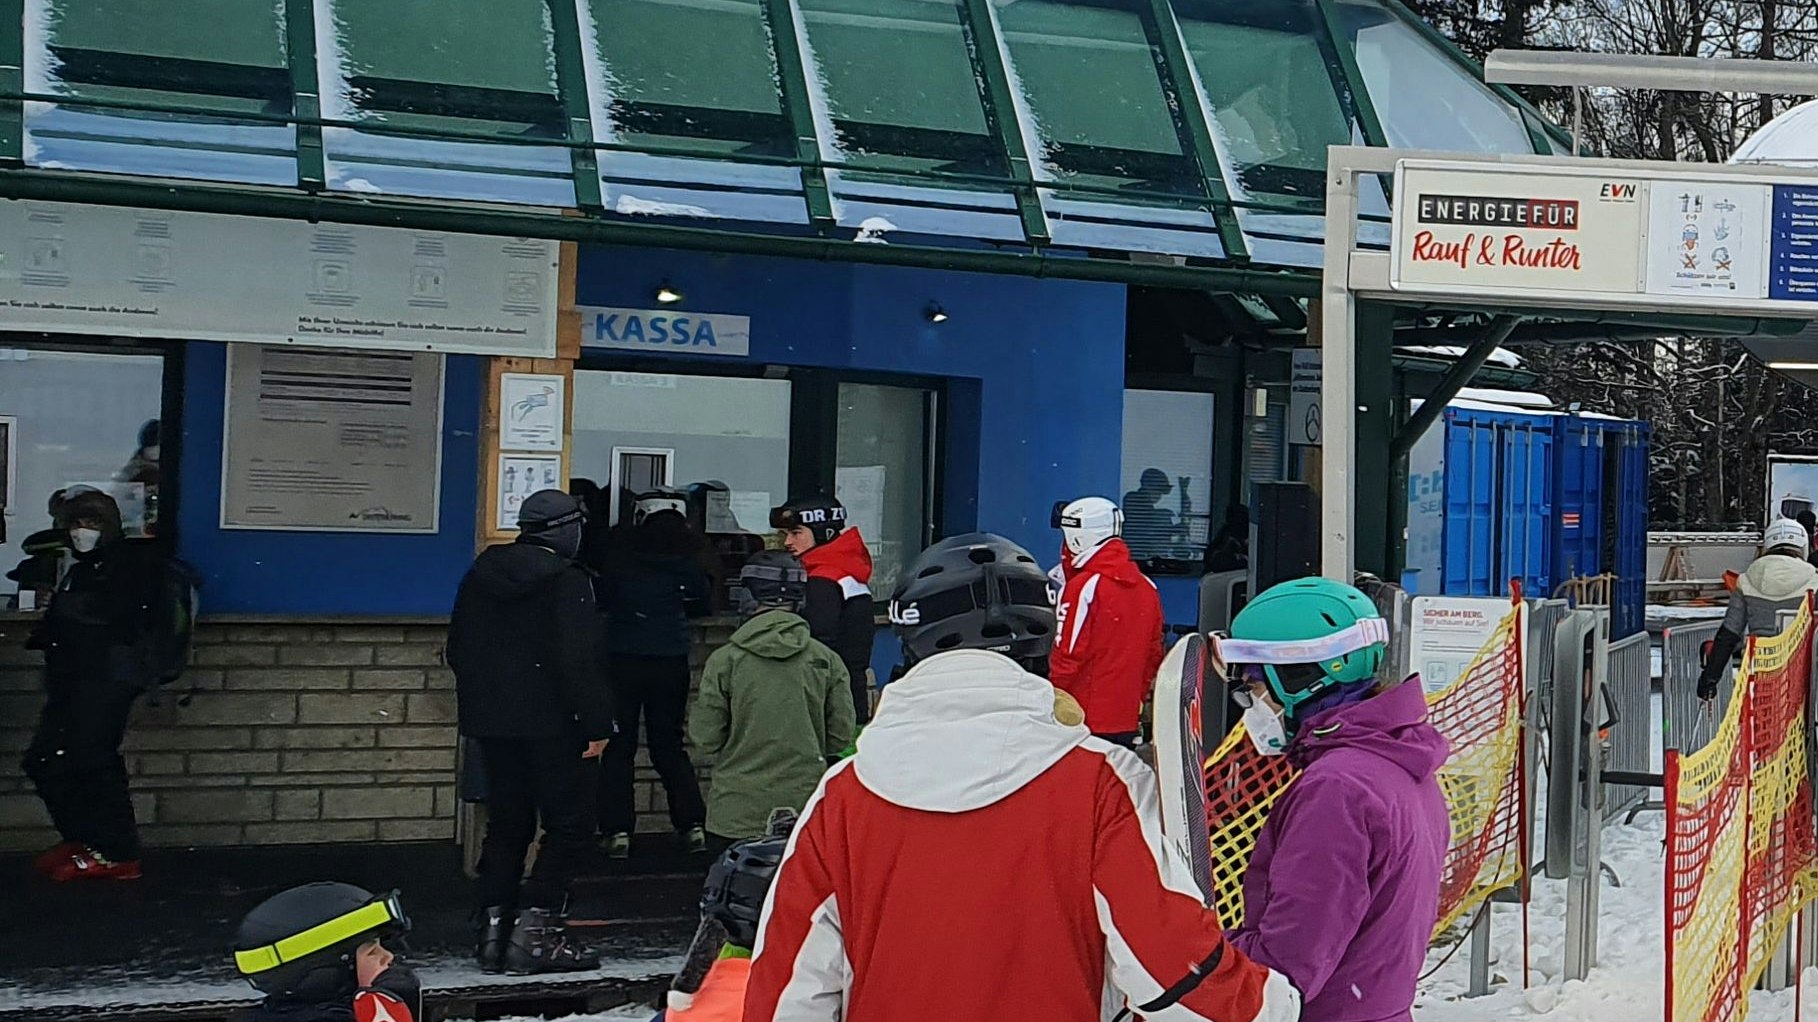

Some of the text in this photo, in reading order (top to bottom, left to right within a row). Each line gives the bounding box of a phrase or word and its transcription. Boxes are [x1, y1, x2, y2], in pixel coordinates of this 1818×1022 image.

[1600, 183, 1637, 198] EVN
[1412, 230, 1582, 271] Rauf & Runter
[596, 313, 717, 347] KASSA
[799, 508, 826, 523] DR
